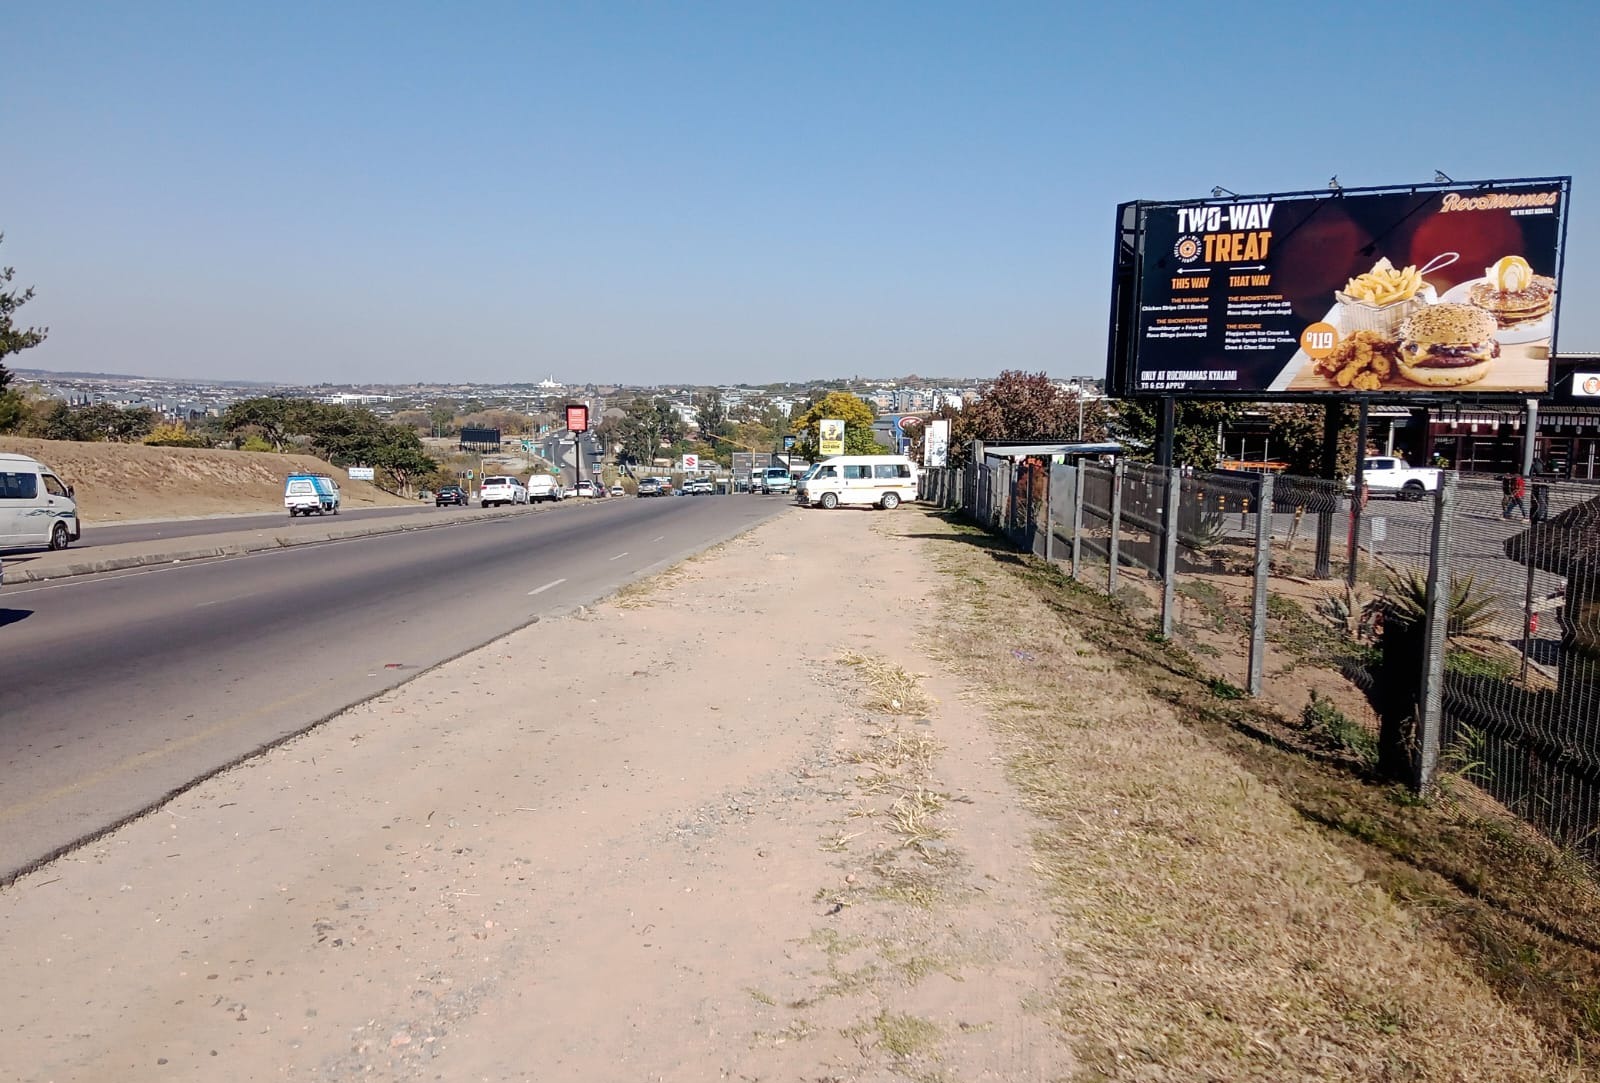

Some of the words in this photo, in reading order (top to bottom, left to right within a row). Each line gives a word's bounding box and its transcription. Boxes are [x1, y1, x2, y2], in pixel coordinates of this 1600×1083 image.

[1177, 203, 1275, 233] TWO-WAY
[1203, 232, 1273, 263] TREAT
[1172, 278, 1190, 290] THIS
[1191, 277, 1211, 289] WAY
[1229, 276, 1251, 288] THAT
[1251, 275, 1271, 286] WAY
[1141, 371, 1156, 381] ONLY
[1157, 370, 1166, 381] AT
[1166, 370, 1208, 381] ROCOMAMAS
[1208, 370, 1238, 380] KYALAMI
